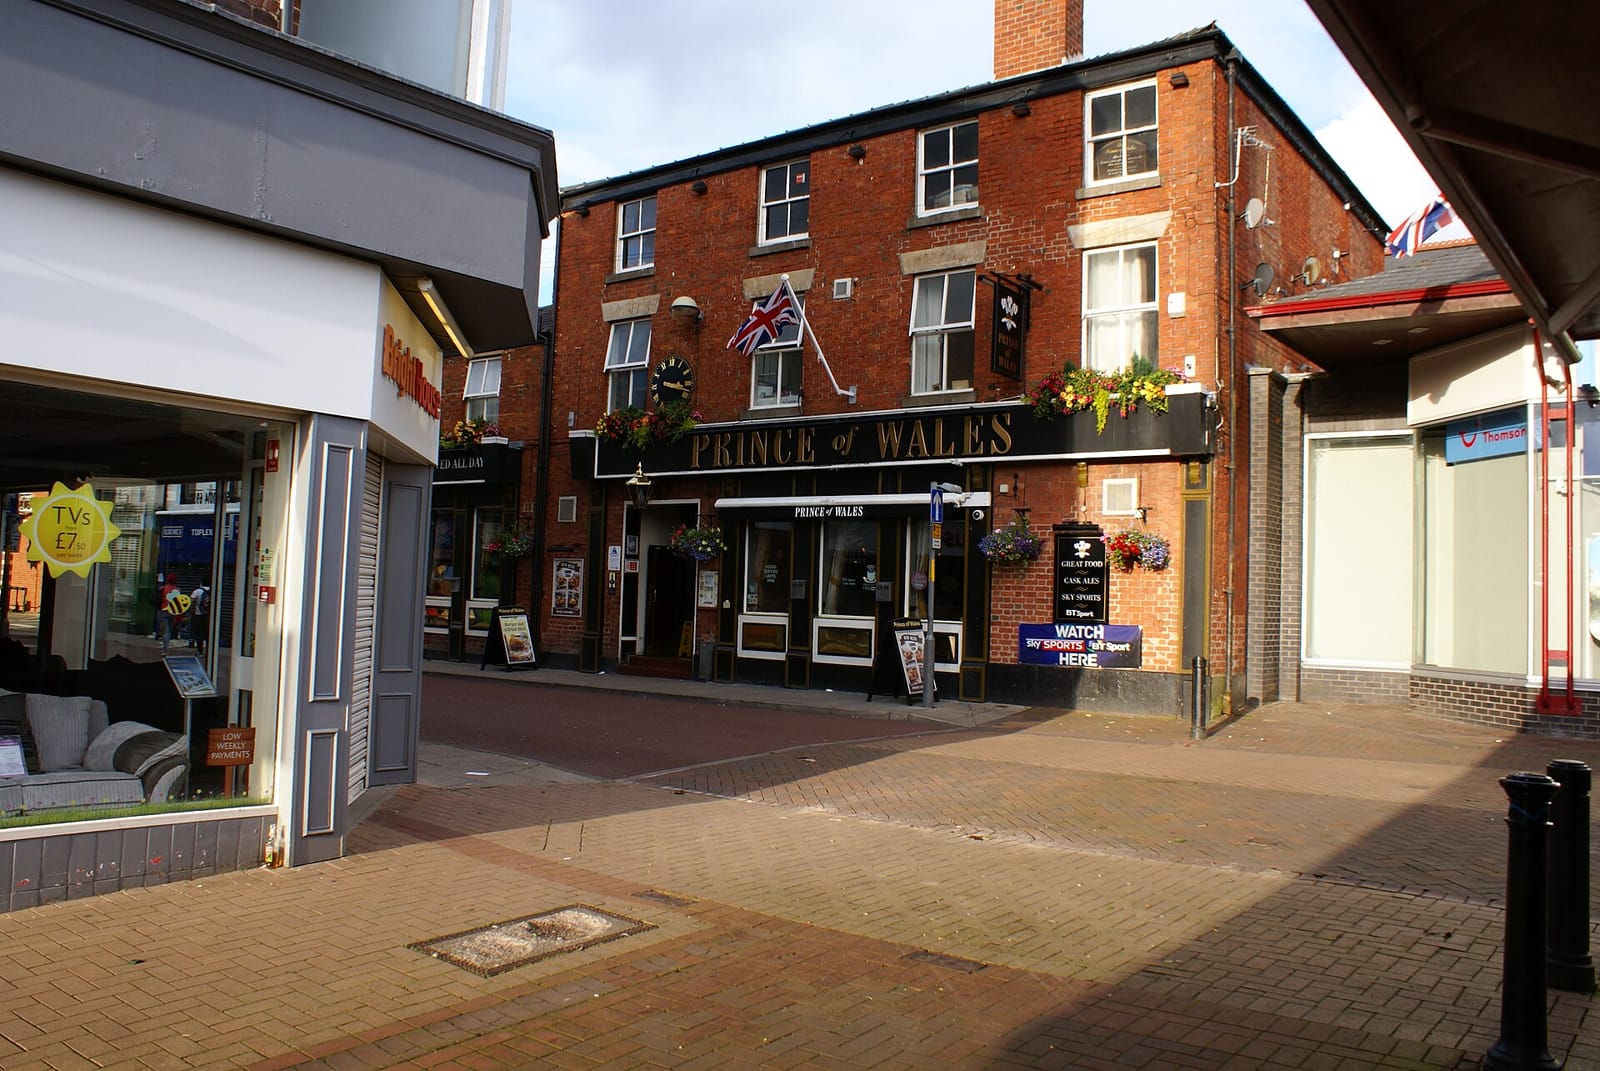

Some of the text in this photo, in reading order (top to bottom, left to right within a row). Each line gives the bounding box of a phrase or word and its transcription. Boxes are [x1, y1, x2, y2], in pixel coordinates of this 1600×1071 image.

[690, 412, 1012, 468] PRINCE of WALES
[1482, 427, 1527, 443] Thomson
[453, 457, 468, 469] ALL
[468, 456, 484, 468] DAY
[52, 506, 91, 526] TVs
[795, 506, 825, 518] PRINCE
[835, 505, 864, 517] WALES
[1061, 560, 1104, 568] GREAT FOOD
[1063, 577, 1100, 585] CASK ALES
[1061, 593, 1102, 602] SKY SPORTS
[1055, 624, 1105, 640] WATCH
[1026, 639, 1041, 650] sky
[1043, 640, 1083, 651] SPORTS
[1059, 652, 1098, 667] HERE
[223, 733, 242, 741] LOW
[216, 742, 247, 750] WEEKLY
[211, 750, 251, 760] PAYMENTS
